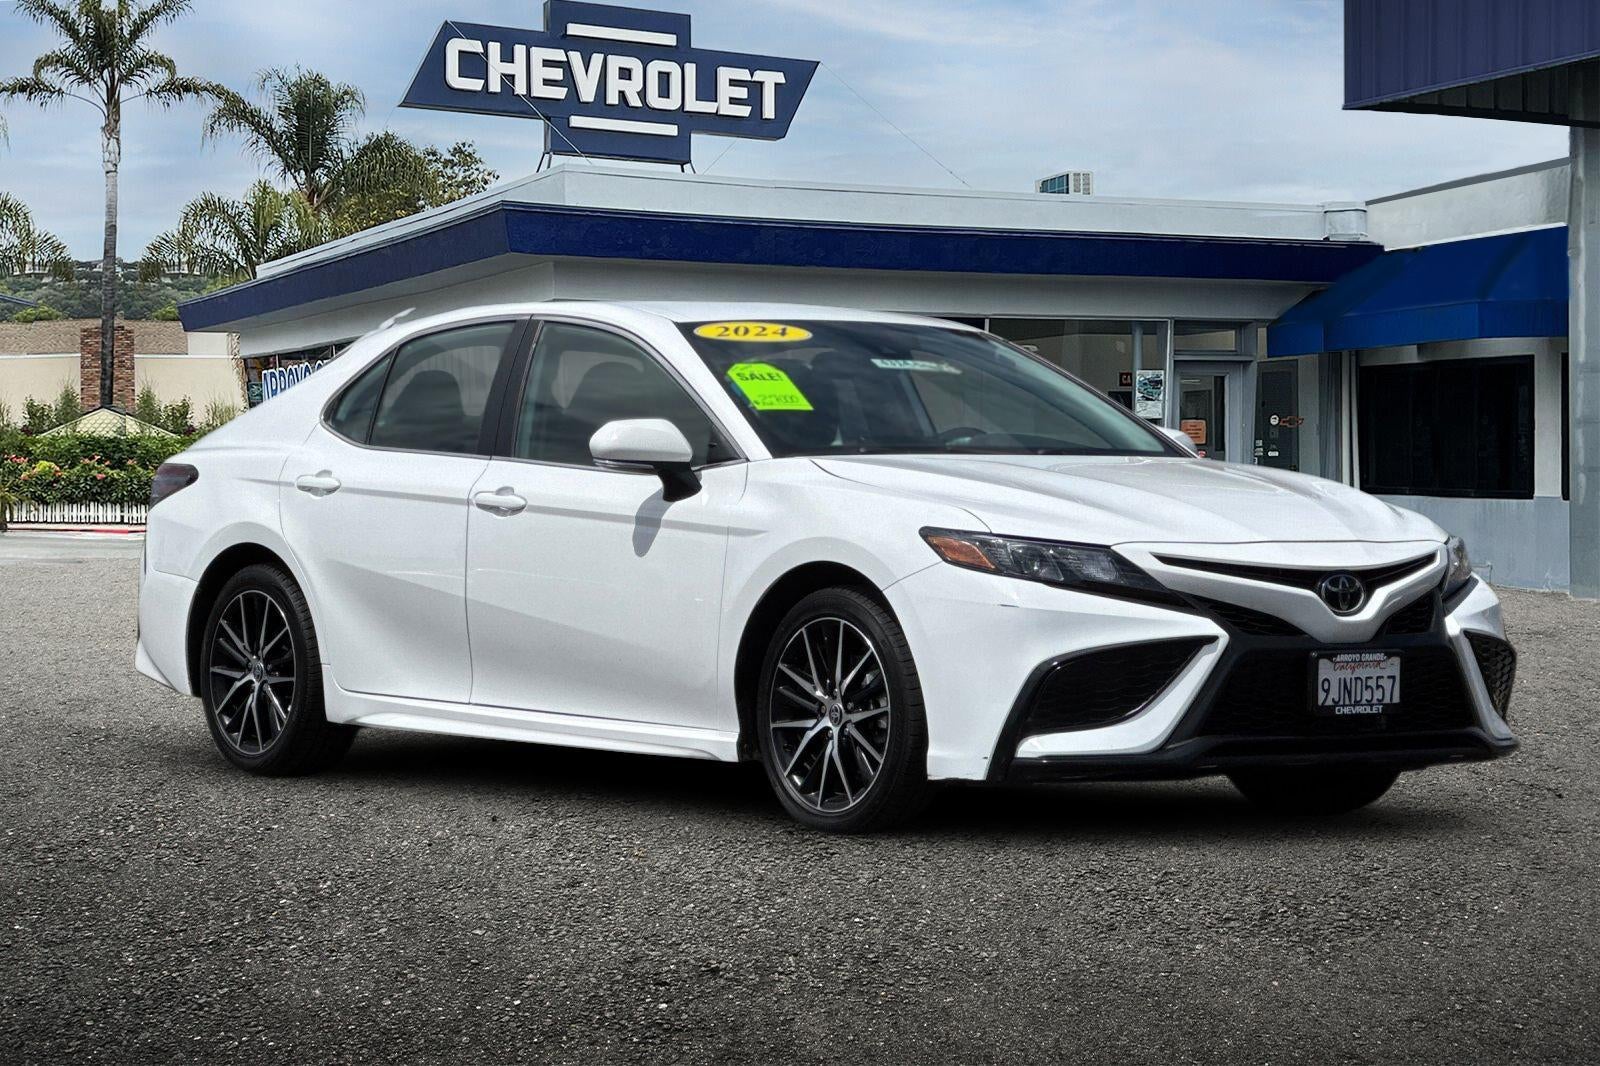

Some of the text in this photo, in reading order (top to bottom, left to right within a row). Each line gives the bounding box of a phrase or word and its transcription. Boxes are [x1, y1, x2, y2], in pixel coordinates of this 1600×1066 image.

[445, 37, 786, 120] CHEVROLET
[716, 325, 788, 337] 2024
[736, 372, 783, 382] SALE!
[1336, 652, 1384, 662] ARROYO GRANDE
[1321, 675, 1396, 705] 9JND557
[1335, 705, 1383, 714] CHEVROLET
